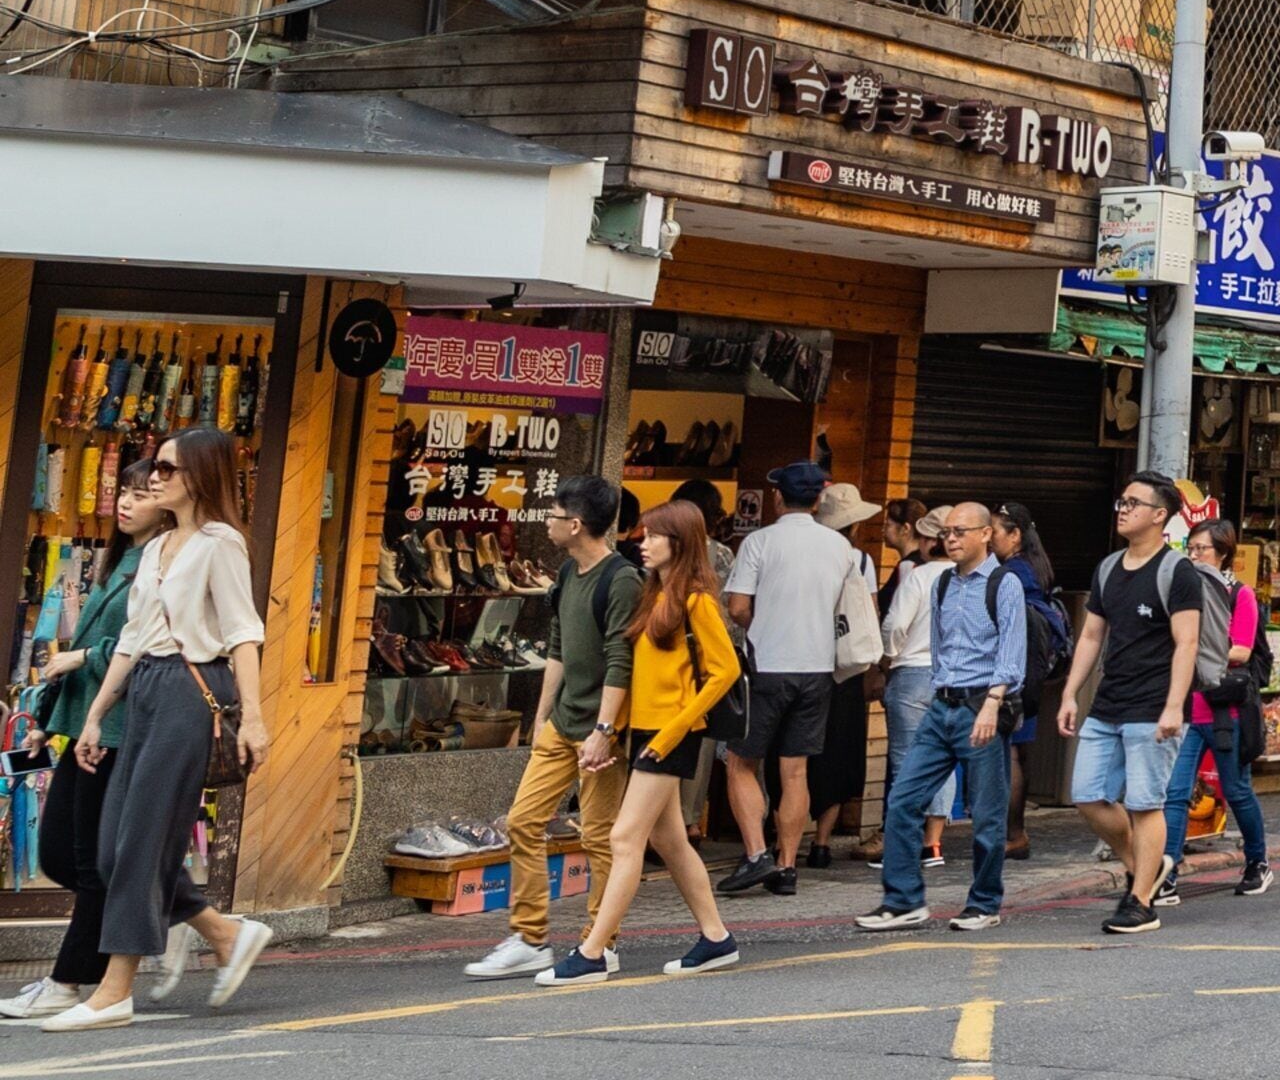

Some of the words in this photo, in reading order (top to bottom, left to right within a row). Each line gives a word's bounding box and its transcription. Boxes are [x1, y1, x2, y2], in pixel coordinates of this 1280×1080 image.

[703, 32, 775, 114] SO
[788, 58, 1009, 157] 台灣手工鞋
[1018, 107, 1113, 178] B-TWO
[965, 188, 1042, 219] 用心做好鞋
[427, 411, 468, 449] SO
[488, 414, 561, 450] B-TWO
[425, 447, 447, 459] San
[449, 448, 465, 459] Ou
[520, 448, 558, 459] Shoemaker
[404, 463, 560, 500] 台灣手工鞋
